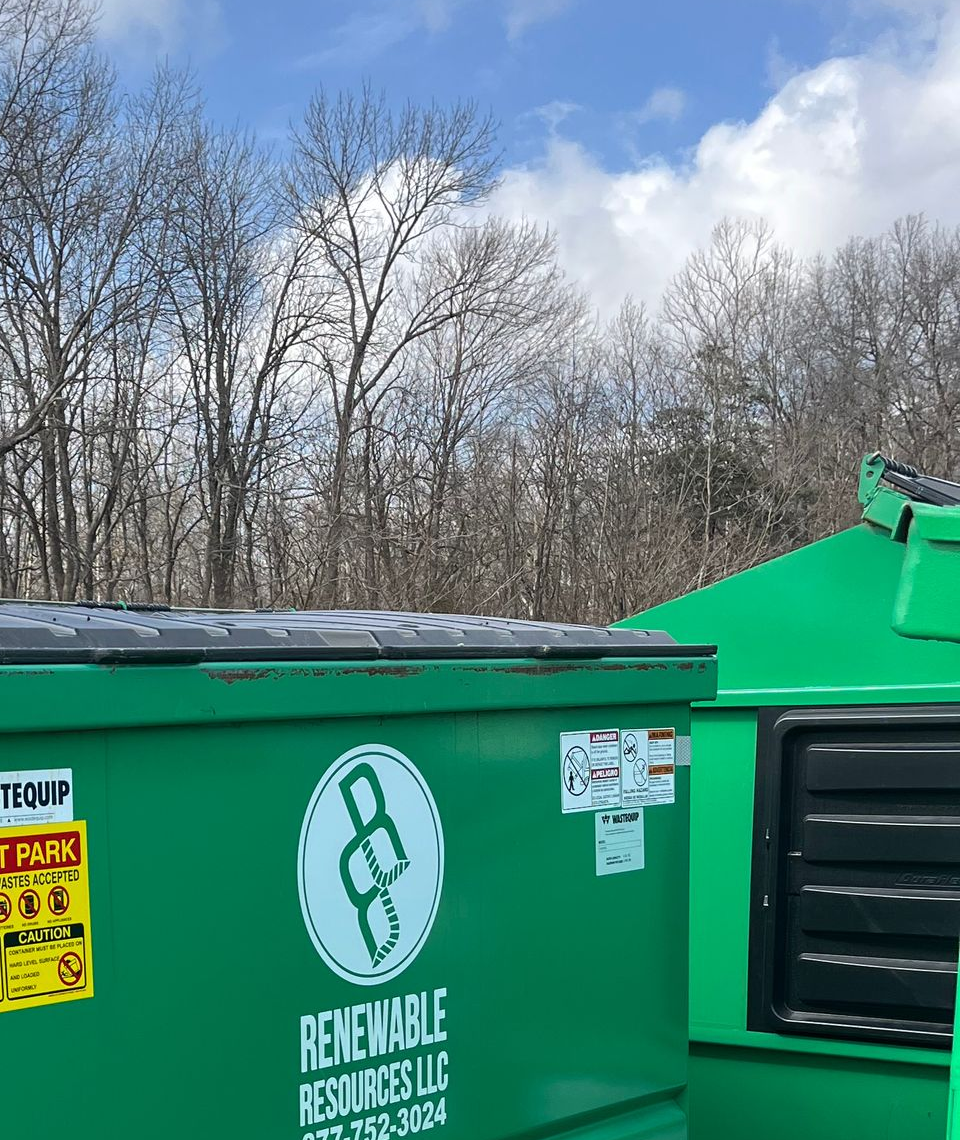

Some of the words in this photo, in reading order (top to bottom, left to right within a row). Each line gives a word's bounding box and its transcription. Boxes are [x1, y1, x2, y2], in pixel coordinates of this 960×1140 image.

[596, 732, 616, 741] DANGER
[596, 769, 618, 778] PELIGRO
[16, 838, 77, 867] PARK
[32, 869, 80, 886] ACCEPTED
[19, 926, 70, 944] CAUTION
[8, 948, 35, 956] CONTAINER
[39, 956, 60, 964] SURFACE
[11, 985, 37, 993] UNIFORMLY
[300, 987, 447, 1073] RENEWABLE
[299, 1059, 412, 1127] RESOURCES
[416, 1050, 449, 1097] LLC
